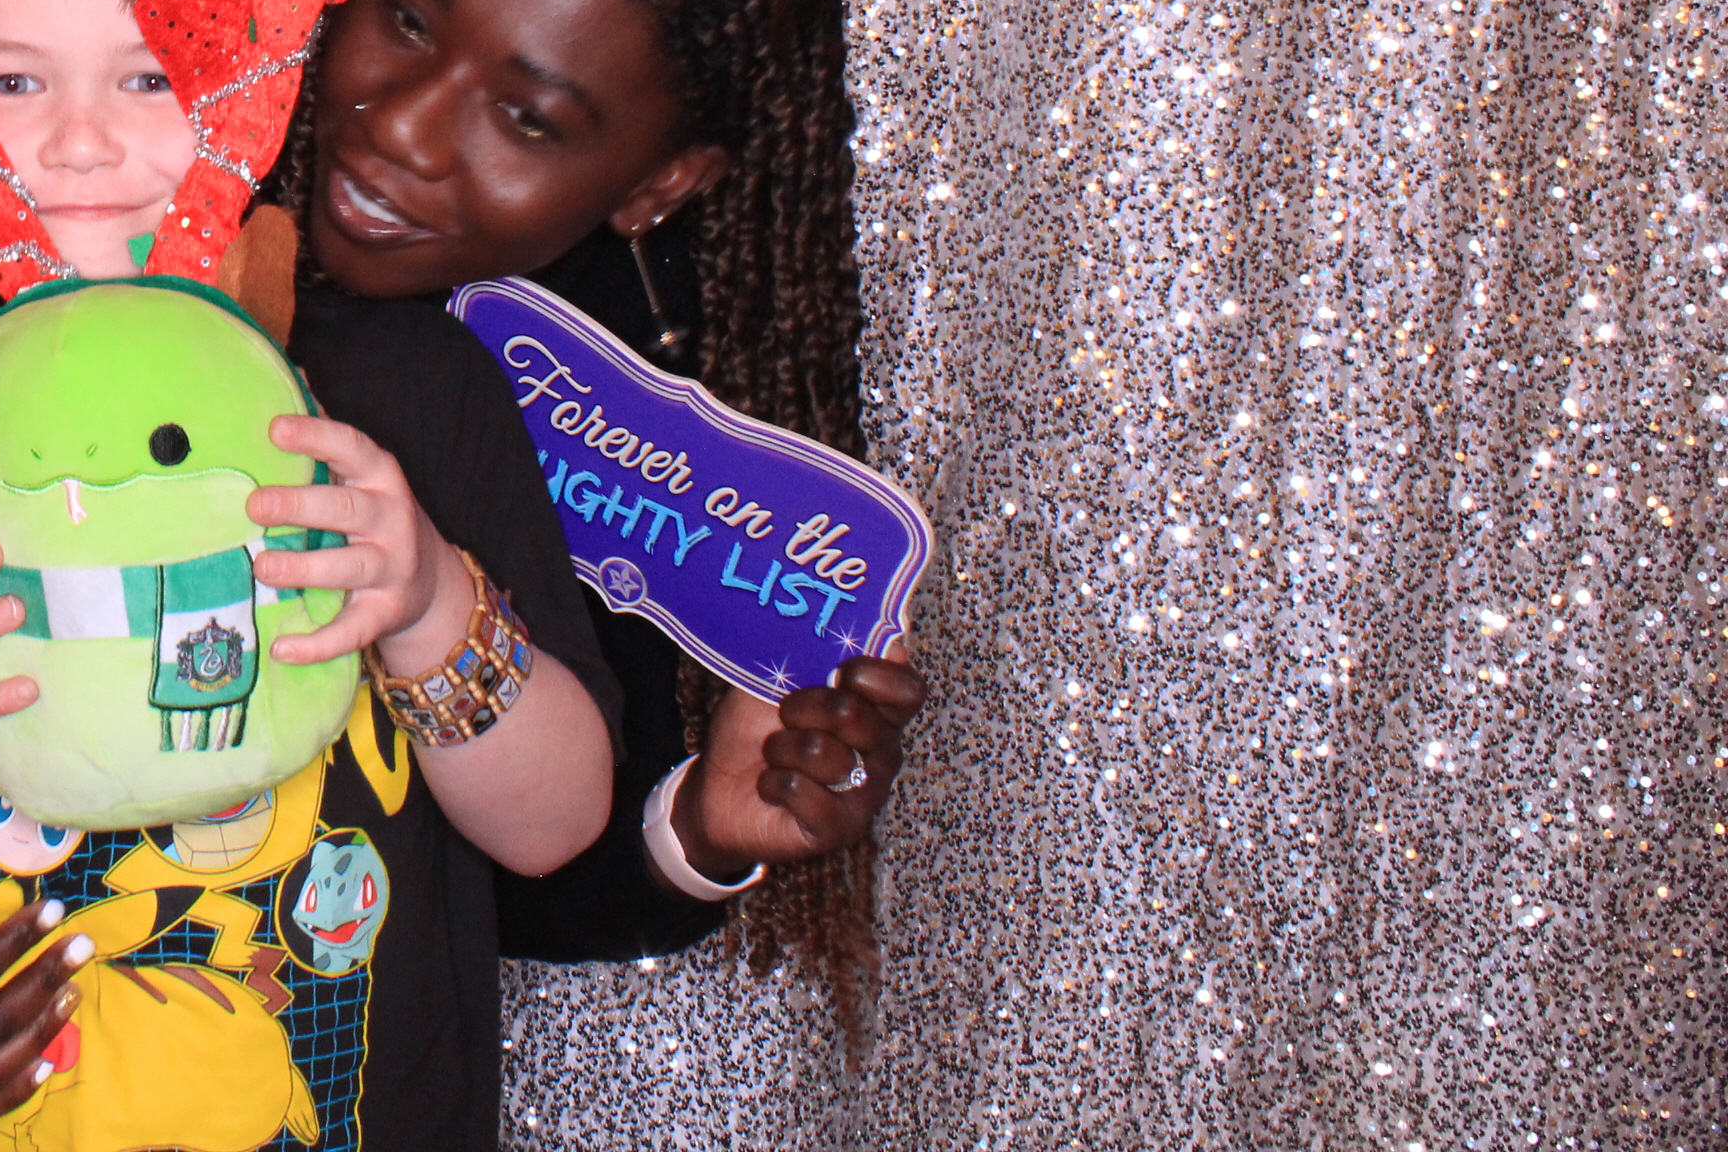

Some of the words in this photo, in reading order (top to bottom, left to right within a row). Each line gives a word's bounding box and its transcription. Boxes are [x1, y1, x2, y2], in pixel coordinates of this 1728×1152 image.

[503, 335, 694, 495] Forever
[704, 486, 775, 540] on
[784, 513, 868, 590] the
[719, 541, 857, 638] LIST
